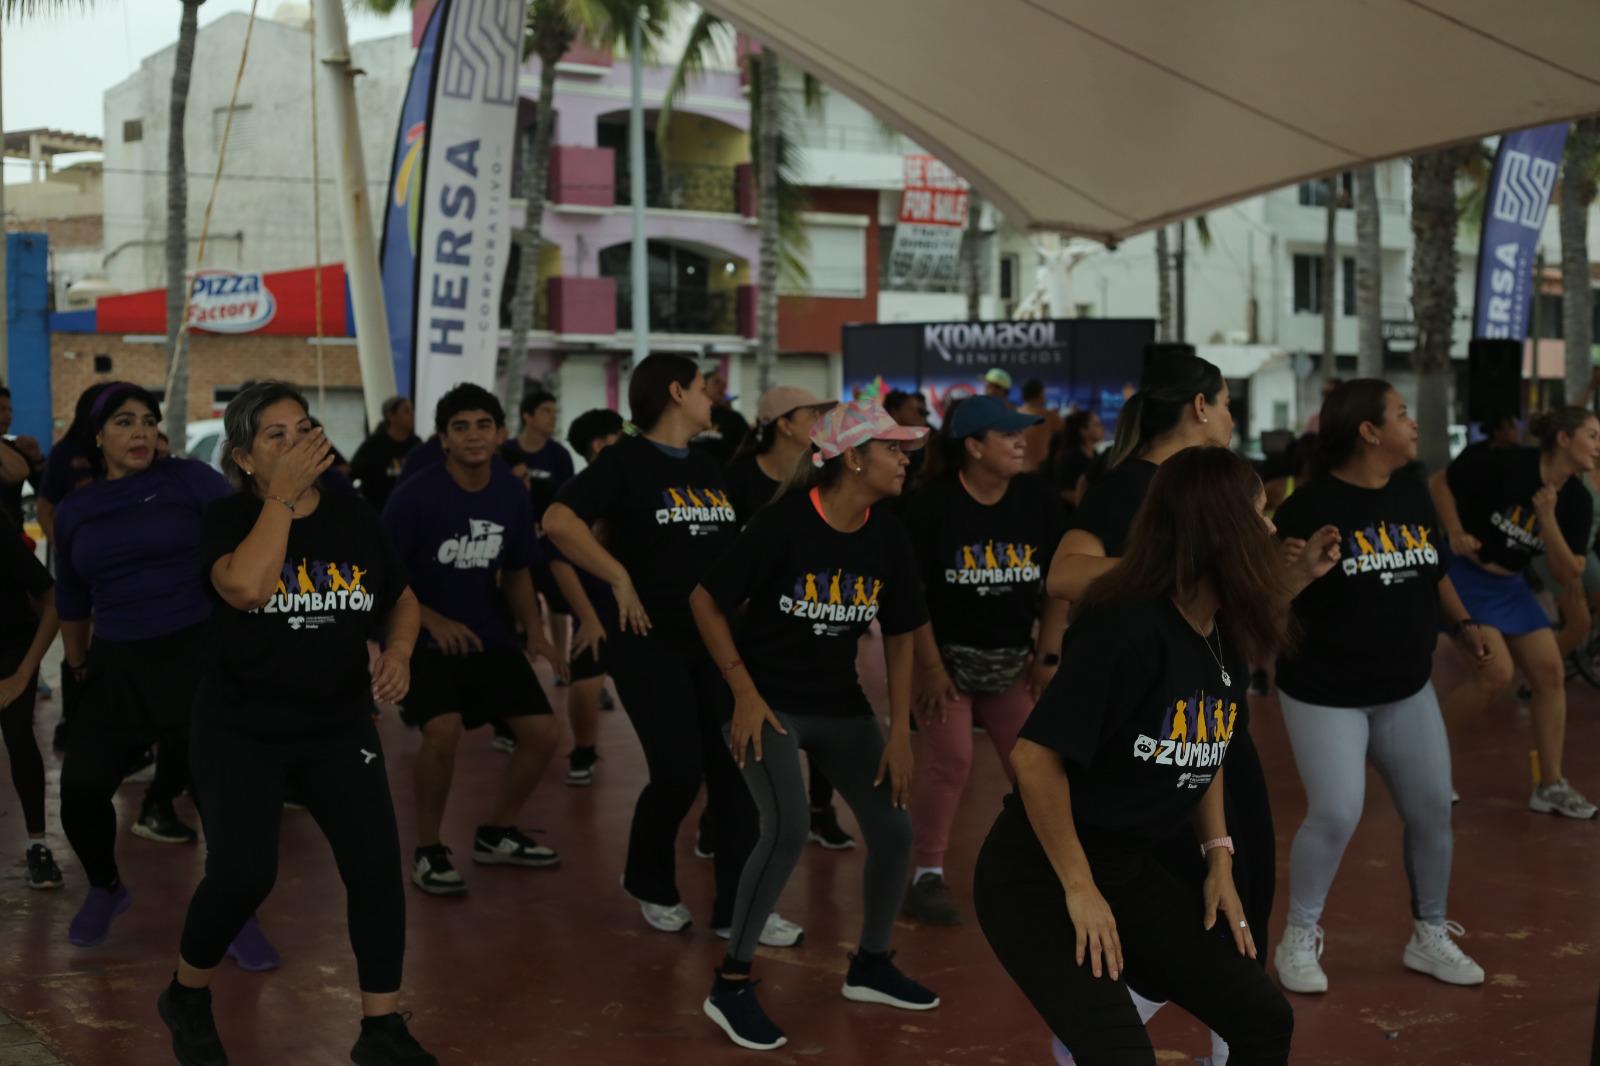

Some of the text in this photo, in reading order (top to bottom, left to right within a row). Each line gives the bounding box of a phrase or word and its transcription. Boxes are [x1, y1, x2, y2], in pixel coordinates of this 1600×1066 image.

[901, 191, 931, 219] FOR
[430, 138, 481, 356] HERSA
[479, 162, 502, 332] CORPORATIVO
[1485, 242, 1519, 340] ERSA
[955, 353, 1063, 366] BENEFICIOS
[263, 585, 374, 614] ZUMBATÓN
